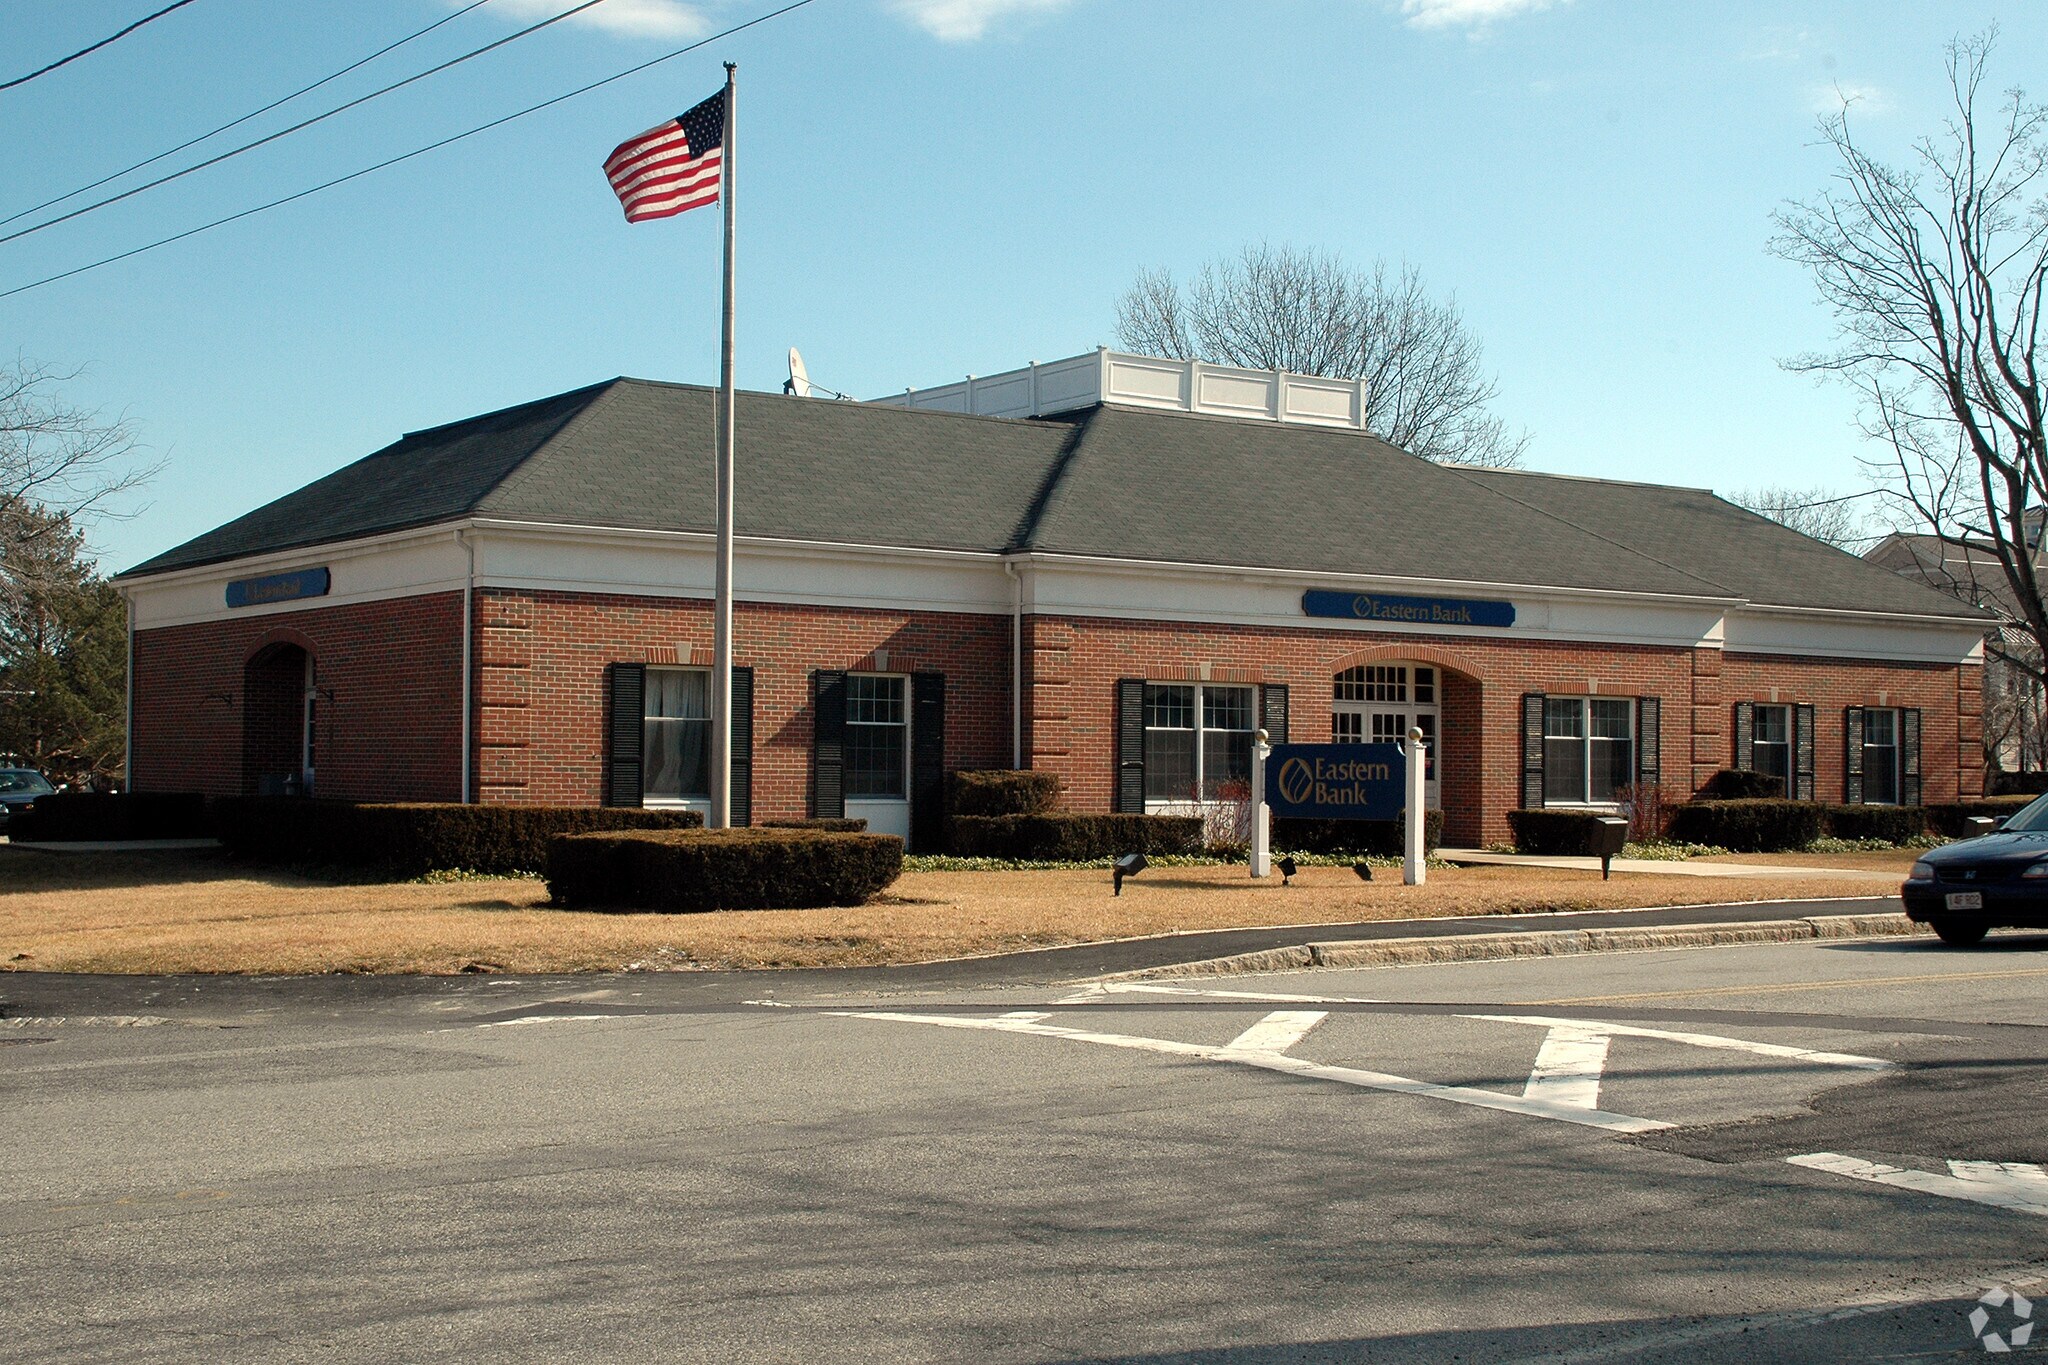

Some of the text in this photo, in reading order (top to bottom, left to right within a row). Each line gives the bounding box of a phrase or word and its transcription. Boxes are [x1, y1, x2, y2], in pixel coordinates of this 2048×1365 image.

[1372, 601, 1472, 622] Eastern Bank
[1315, 757, 1390, 781] Eastern
[1315, 781, 1368, 805] Bank
